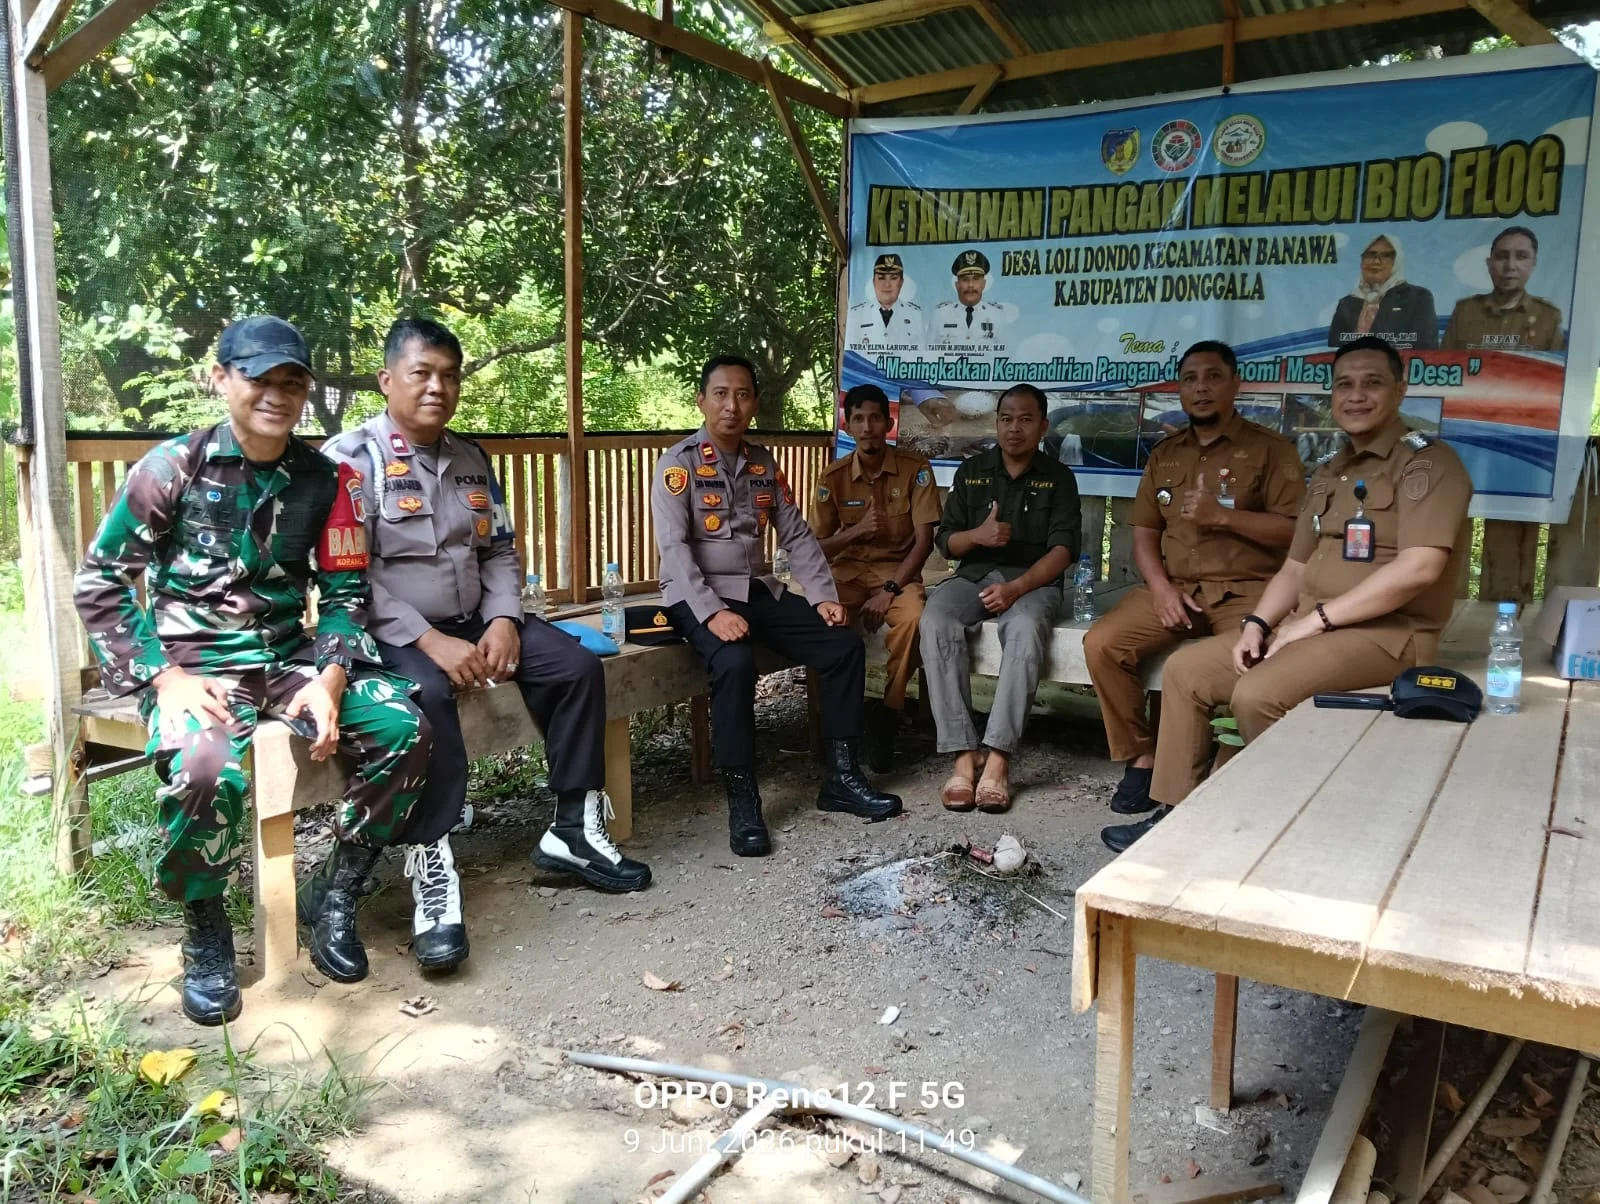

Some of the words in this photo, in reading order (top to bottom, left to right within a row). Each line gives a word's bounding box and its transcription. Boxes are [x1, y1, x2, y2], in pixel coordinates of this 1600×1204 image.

[867, 184, 1046, 245] KETAHANAN
[1048, 177, 1191, 238] PANGAN
[1191, 162, 1361, 229] MELALUI
[1360, 151, 1446, 222] BIO
[1445, 134, 1565, 219] FLOG
[1001, 250, 1041, 276] DESA
[1045, 247, 1080, 274] LOLI
[1082, 243, 1140, 272] DONDO
[1143, 237, 1252, 269] KECAMATAN
[1255, 234, 1338, 265] BANAWA
[1054, 276, 1157, 306] KABUPATEN
[1161, 271, 1265, 302] DONGGALA
[1119, 332, 1165, 354] Tema
[1483, 334, 1520, 344] IRFAN
[992, 356, 1094, 382] Kemandirian
[1096, 355, 1161, 388] Pangan
[1408, 357, 1463, 386] Desa
